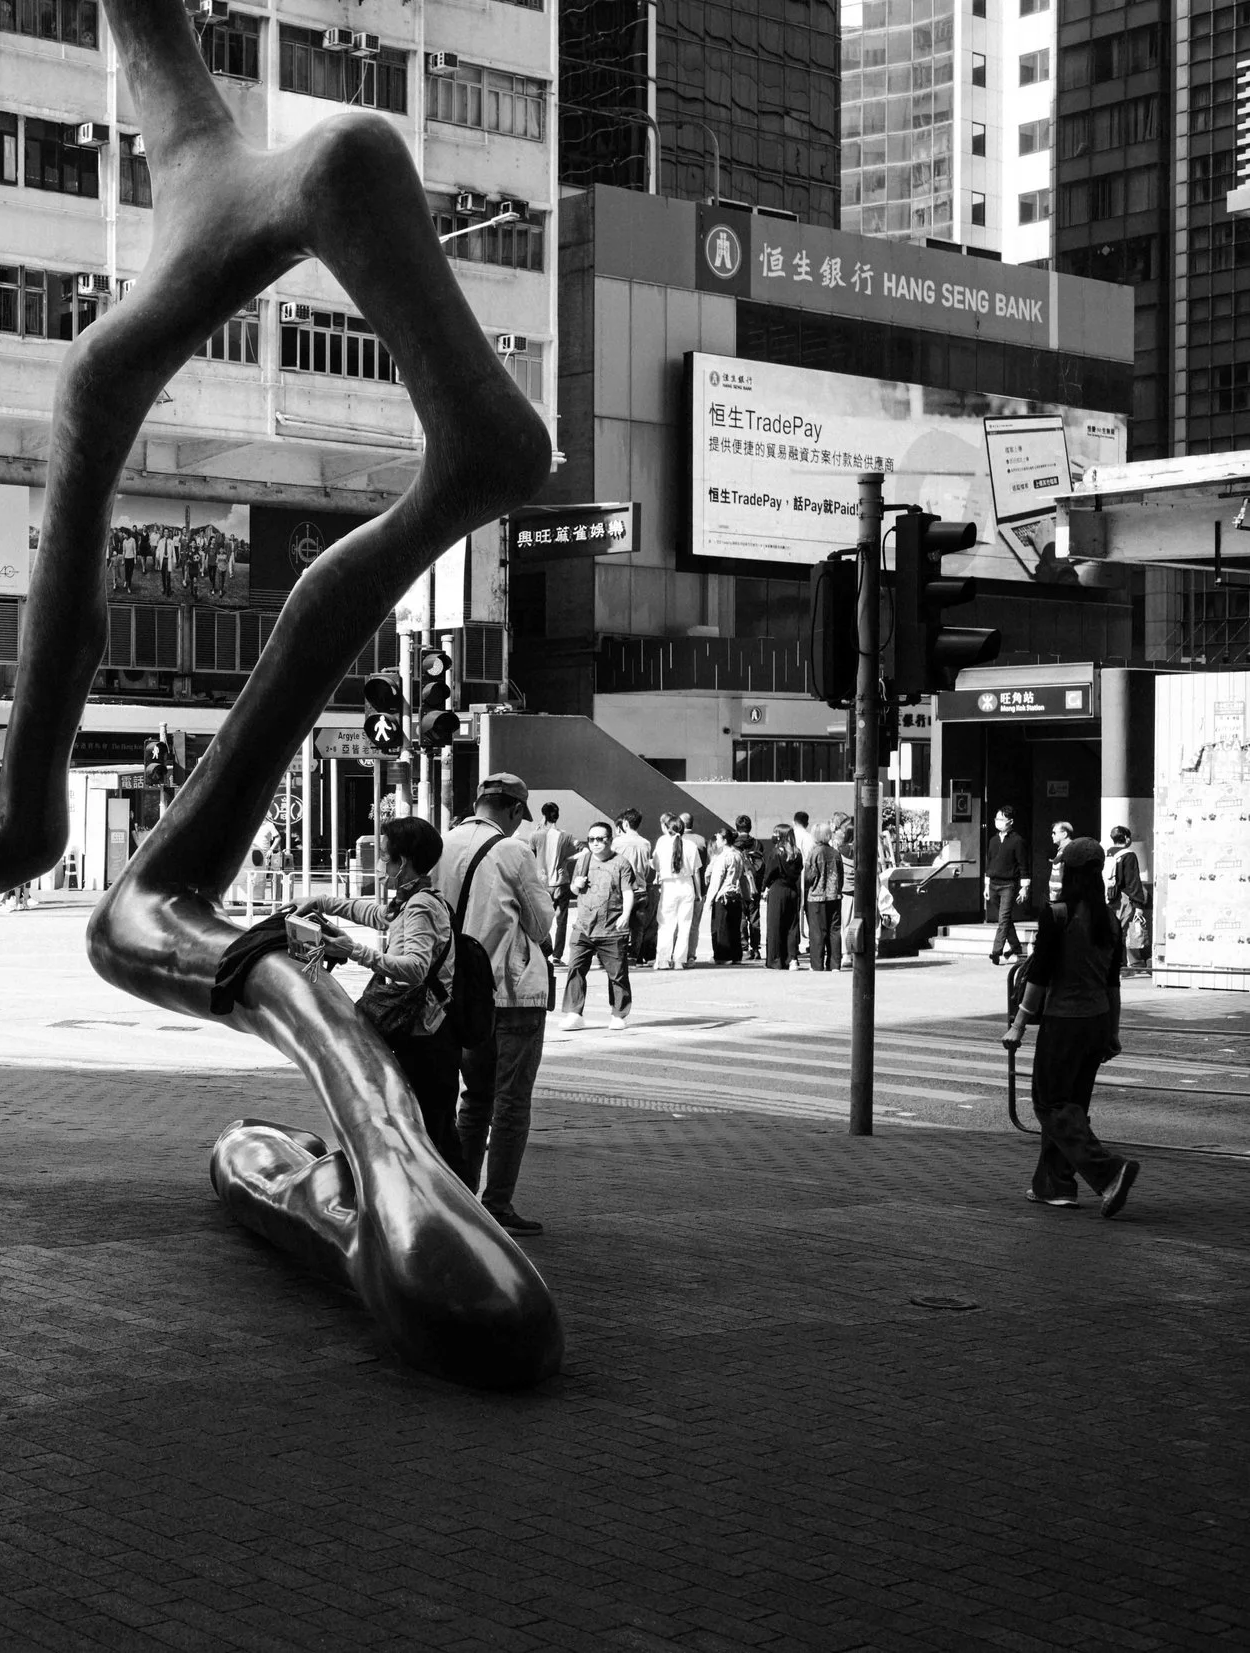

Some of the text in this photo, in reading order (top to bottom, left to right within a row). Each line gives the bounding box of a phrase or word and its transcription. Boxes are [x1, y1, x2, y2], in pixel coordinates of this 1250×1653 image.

[759, 243, 1043, 324] 恒生銀行 HANG SENG BANK
[1000, 691, 1035, 705] 旺角站
[1000, 705, 1015, 713] Mong
[338, 732, 359, 742] Argyle
